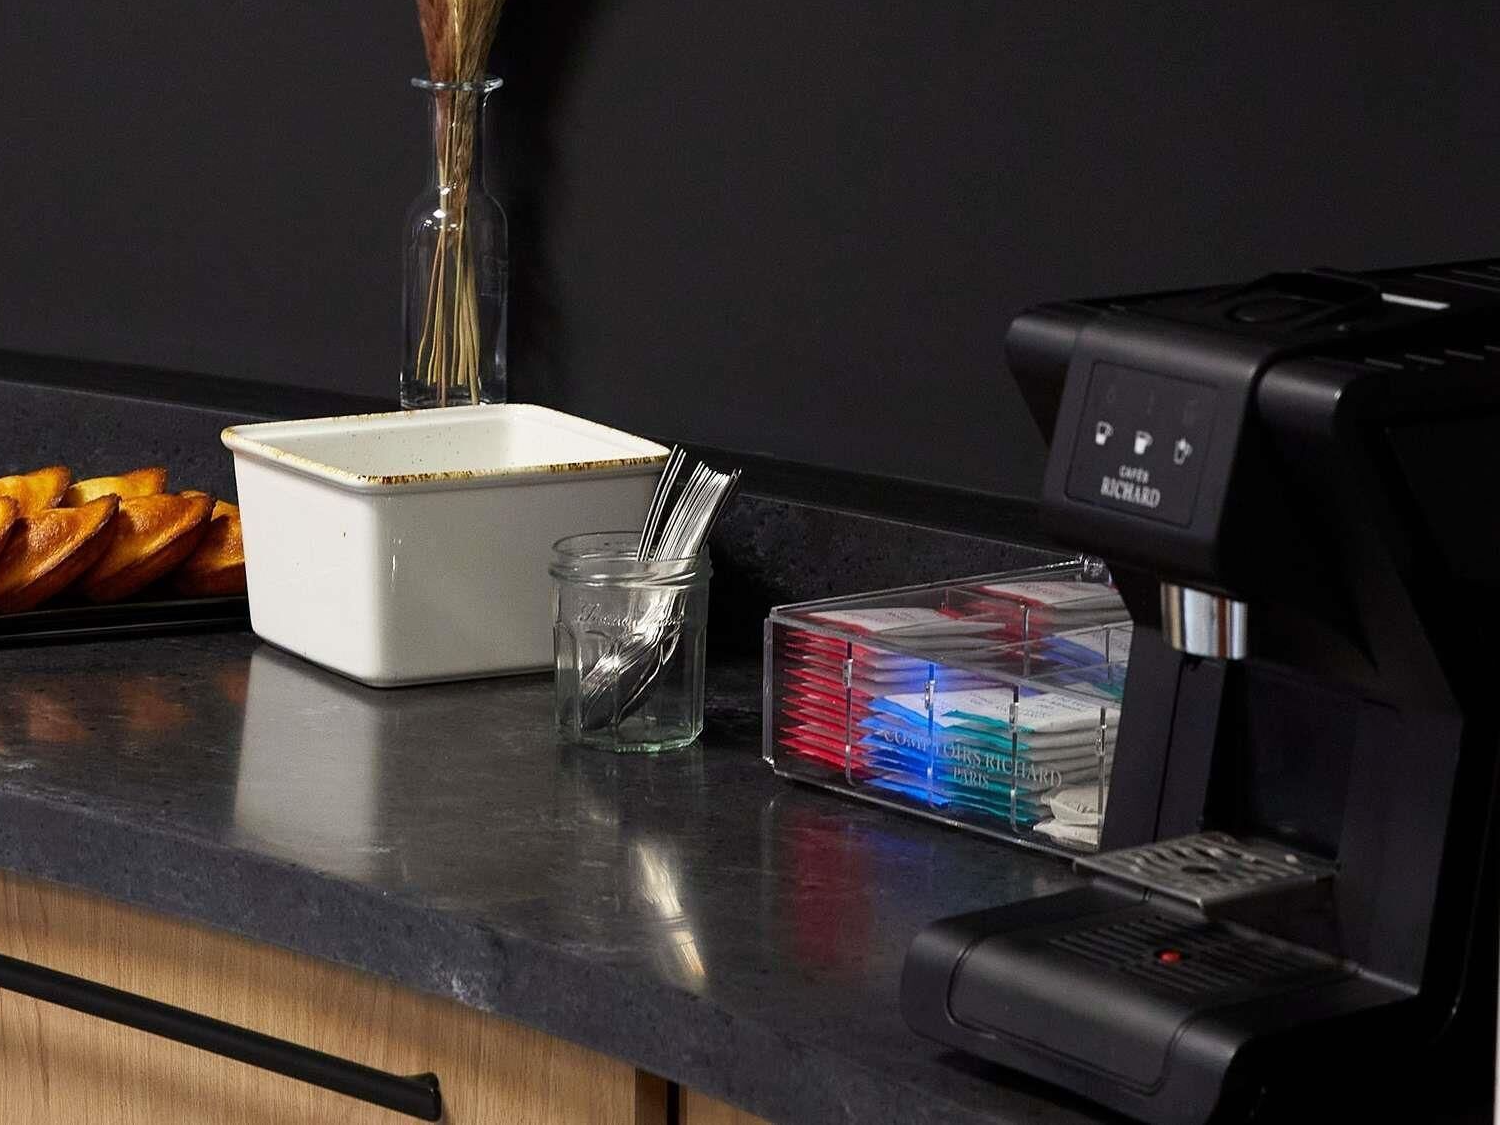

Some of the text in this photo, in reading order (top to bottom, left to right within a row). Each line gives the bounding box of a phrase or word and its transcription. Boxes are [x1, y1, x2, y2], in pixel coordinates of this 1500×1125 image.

[1100, 476, 1161, 508] RICHARD
[953, 766, 989, 789] PARIS
[984, 752, 1062, 789] RICHARD
